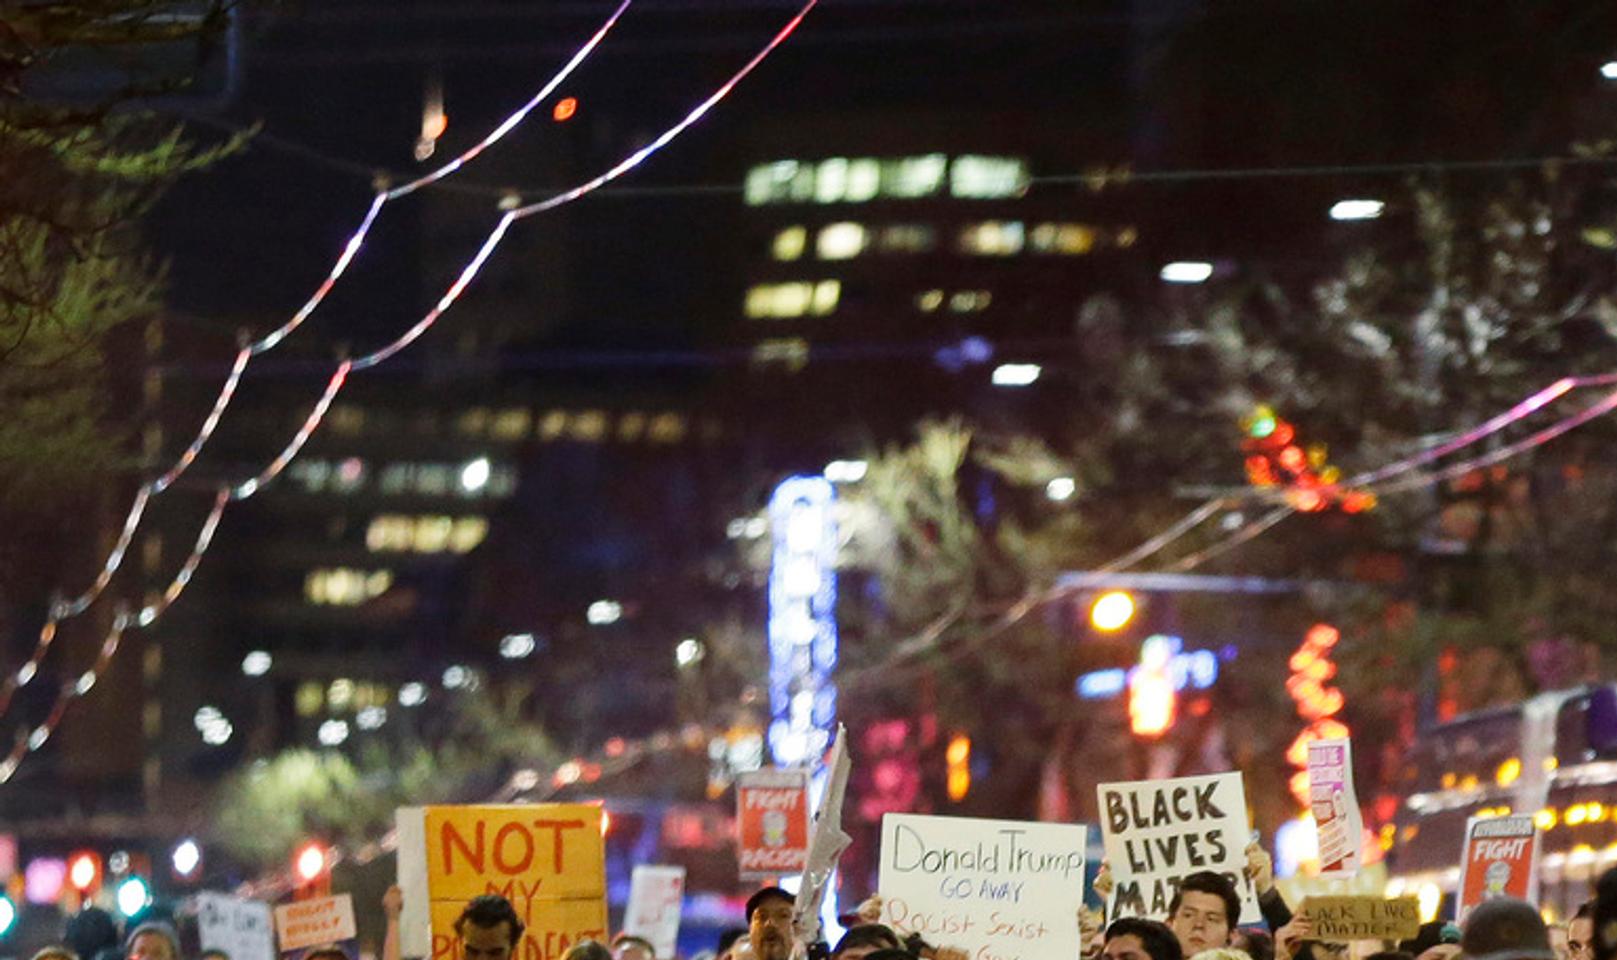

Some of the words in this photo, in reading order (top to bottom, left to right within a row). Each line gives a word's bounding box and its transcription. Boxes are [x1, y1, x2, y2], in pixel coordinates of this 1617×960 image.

[1105, 780, 1227, 835] BLACK
[440, 819, 585, 876] NOT
[892, 823, 999, 874] Donald
[1000, 829, 1084, 880] Trump
[1124, 829, 1227, 875] LIVES
[1473, 838, 1529, 862] FIGHT
[940, 876, 974, 899] GO
[979, 879, 1025, 903] AWAY
[887, 898, 975, 936] Racist
[985, 911, 1050, 941] Sexist
